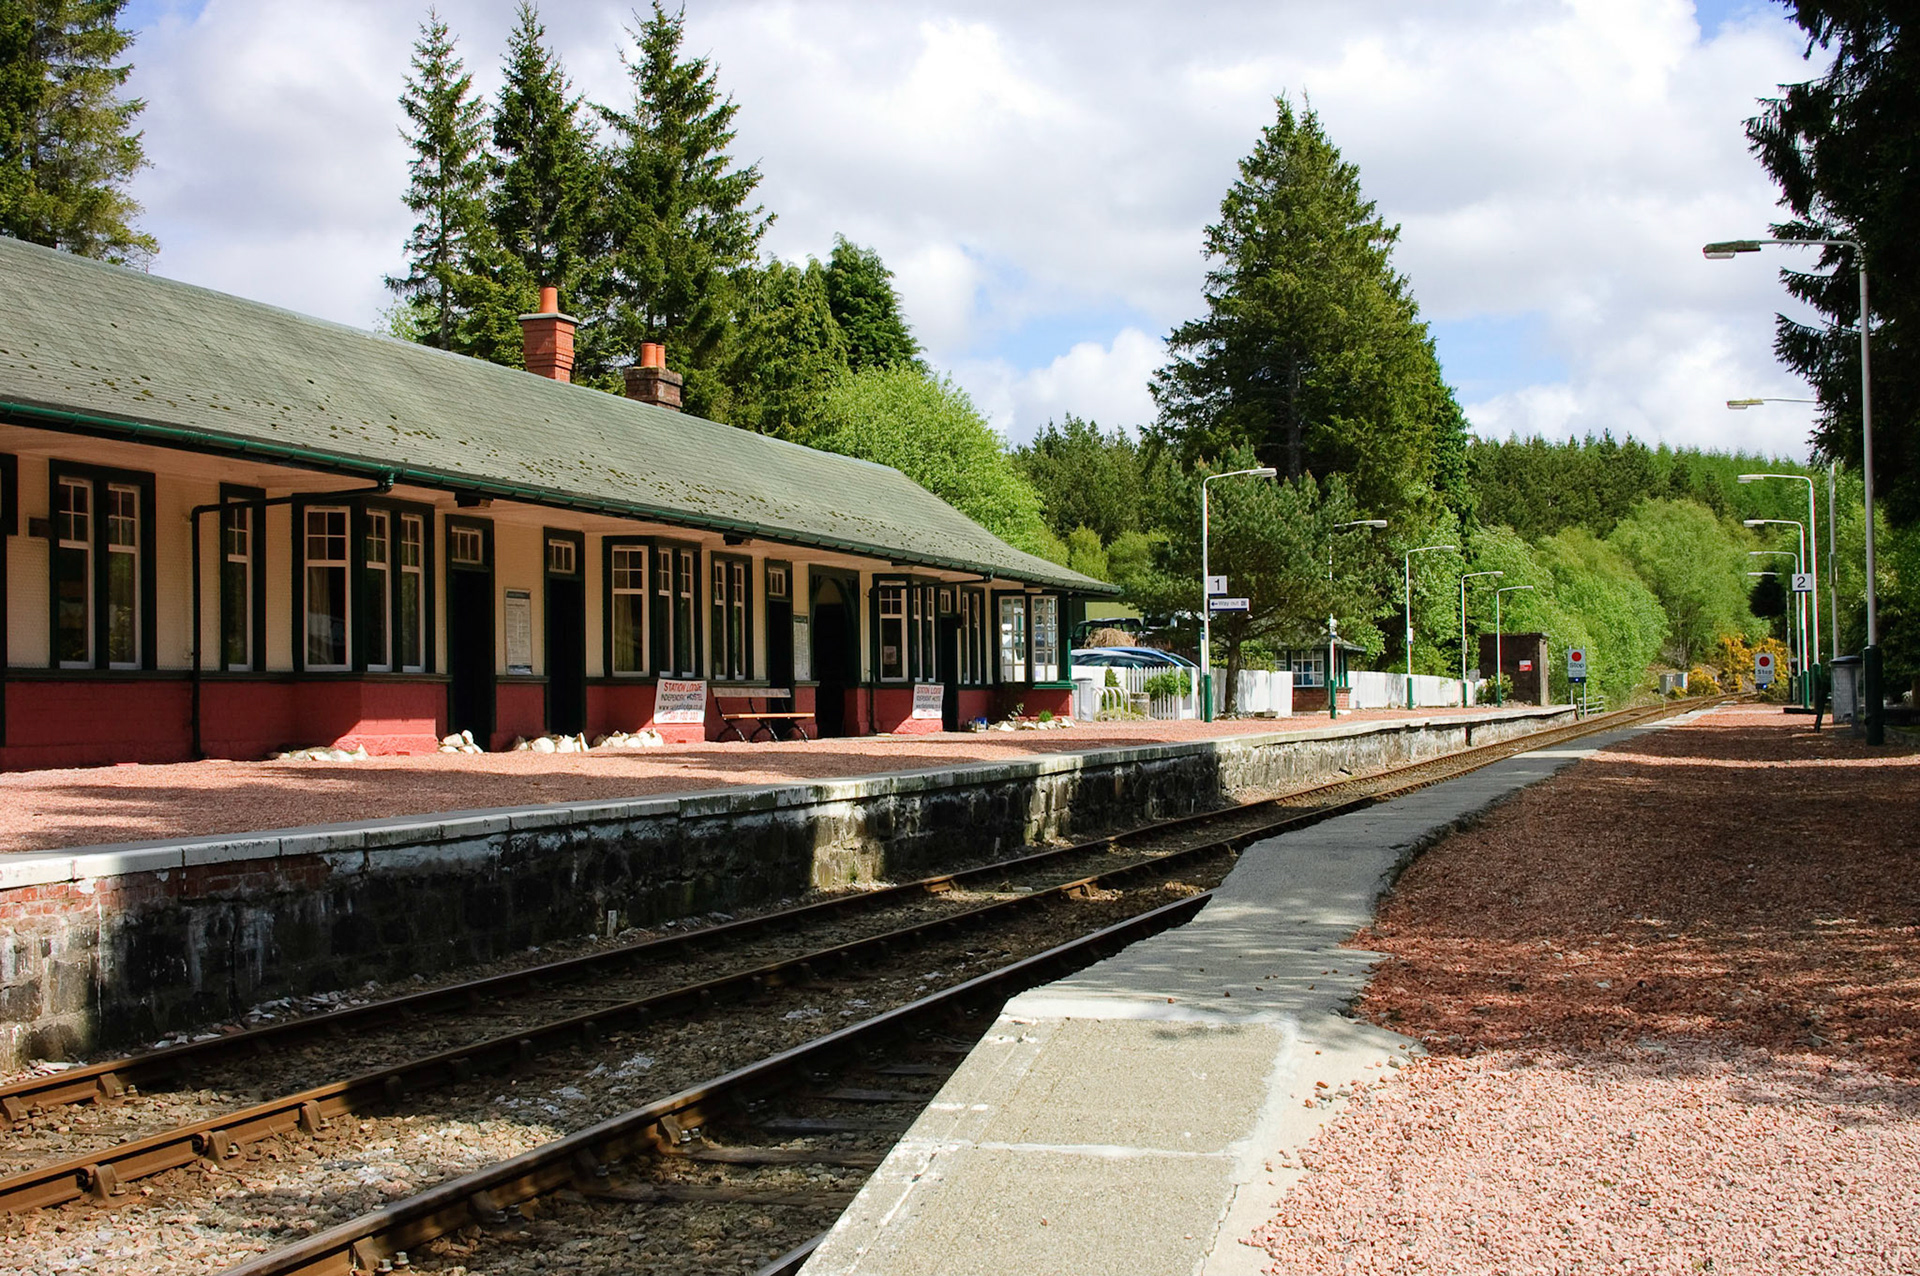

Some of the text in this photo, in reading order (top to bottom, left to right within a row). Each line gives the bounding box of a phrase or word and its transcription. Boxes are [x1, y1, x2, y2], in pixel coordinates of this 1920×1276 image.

[1214, 578, 1220, 591] 1
[1797, 576, 1806, 588] 2
[664, 681, 703, 692] STATION LODGE
